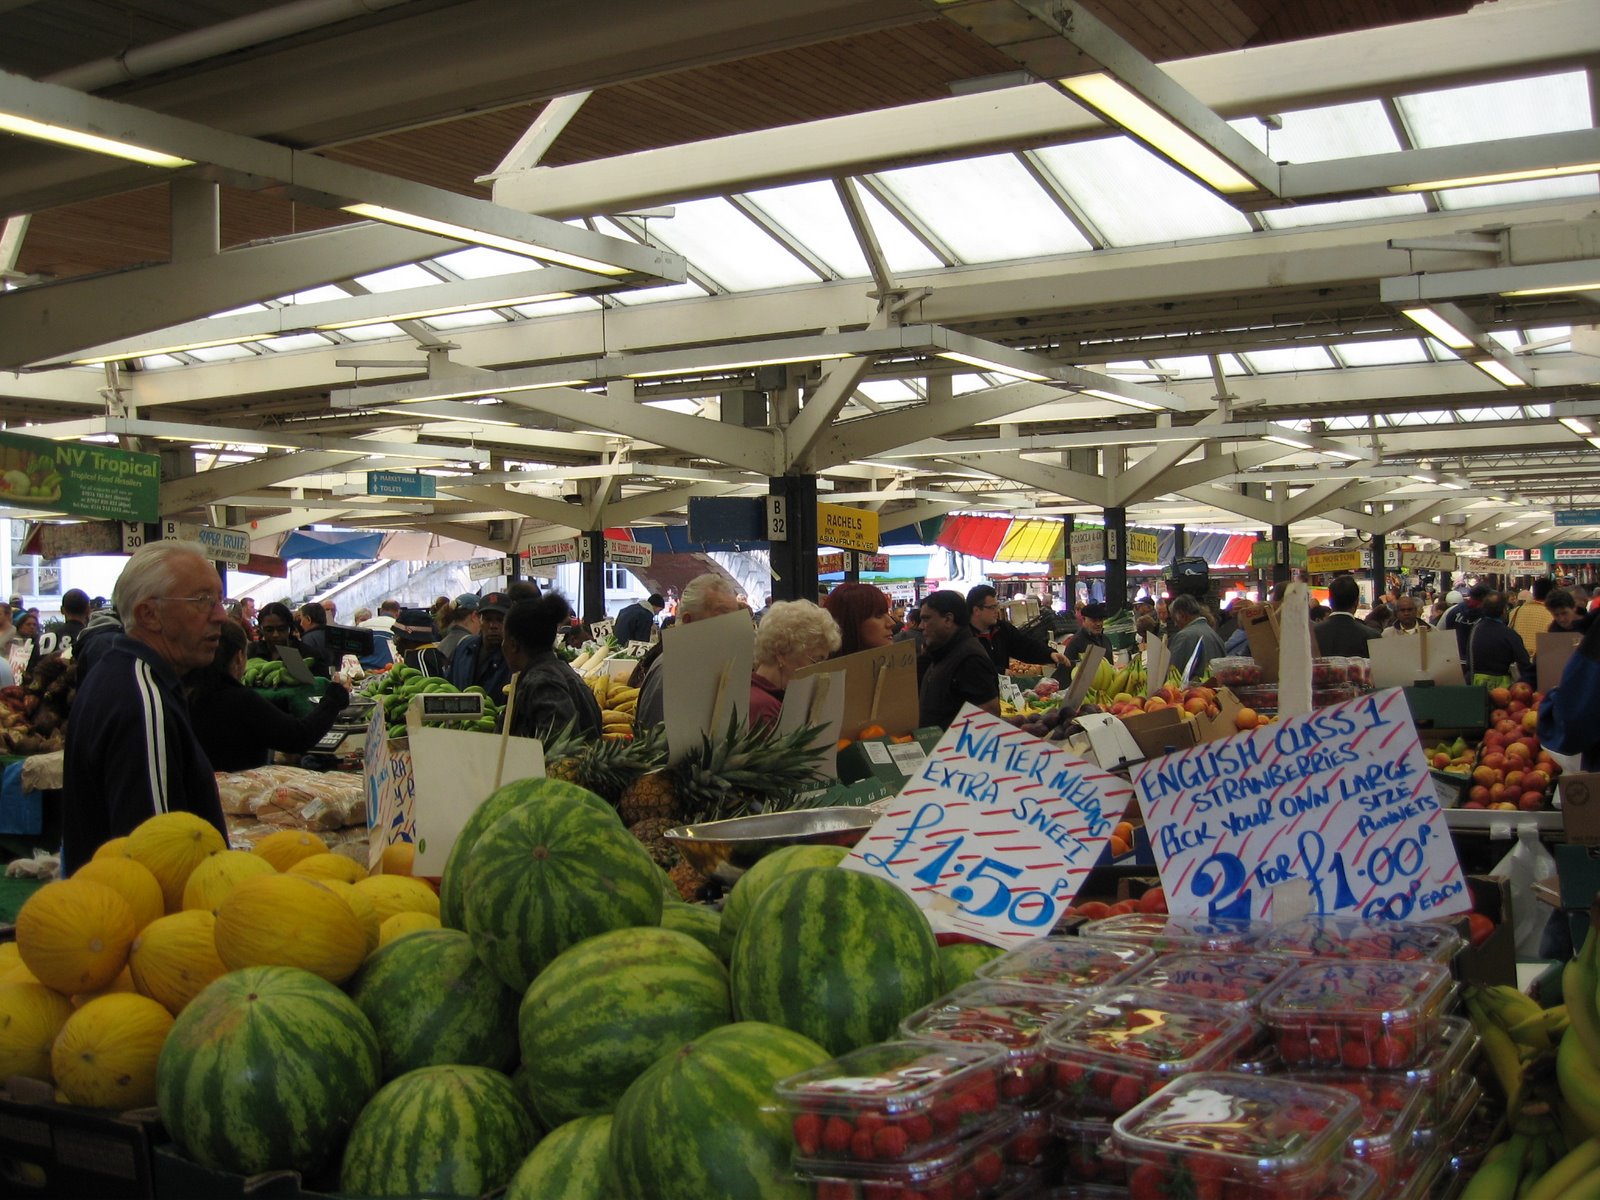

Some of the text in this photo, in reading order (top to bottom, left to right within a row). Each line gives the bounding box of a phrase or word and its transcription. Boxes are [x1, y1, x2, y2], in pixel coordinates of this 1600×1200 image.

[56, 447, 157, 478] NV Tropical
[71, 471, 96, 481] Tropical
[380, 475, 401, 483] MARKET
[380, 485, 402, 493] TOILETS
[774, 500, 781, 514] B
[130, 522, 138, 533] B
[167, 522, 175, 533] B
[773, 518, 785, 533] 32
[826, 514, 862, 530] RACHELS
[825, 527, 835, 536] PICK
[127, 536, 142, 547] 30
[820, 535, 839, 543] ASIAN
[840, 538, 855, 547] FRUIT
[1323, 554, 1355, 562] NORTON
[593, 625, 609, 637] 95
[1141, 698, 1391, 803] ENGLISH CLASS 1
[922, 760, 999, 804] EXTRA
[955, 719, 1112, 837] WATER MELONS
[1279, 785, 1331, 818] OWN
[1339, 753, 1417, 800] LARGE
[1358, 782, 1414, 812] SIZE
[1012, 796, 1092, 864] SWEET
[1190, 852, 1253, 921] 2
[1254, 853, 1299, 889] FOR
[1419, 881, 1463, 911] EACH
